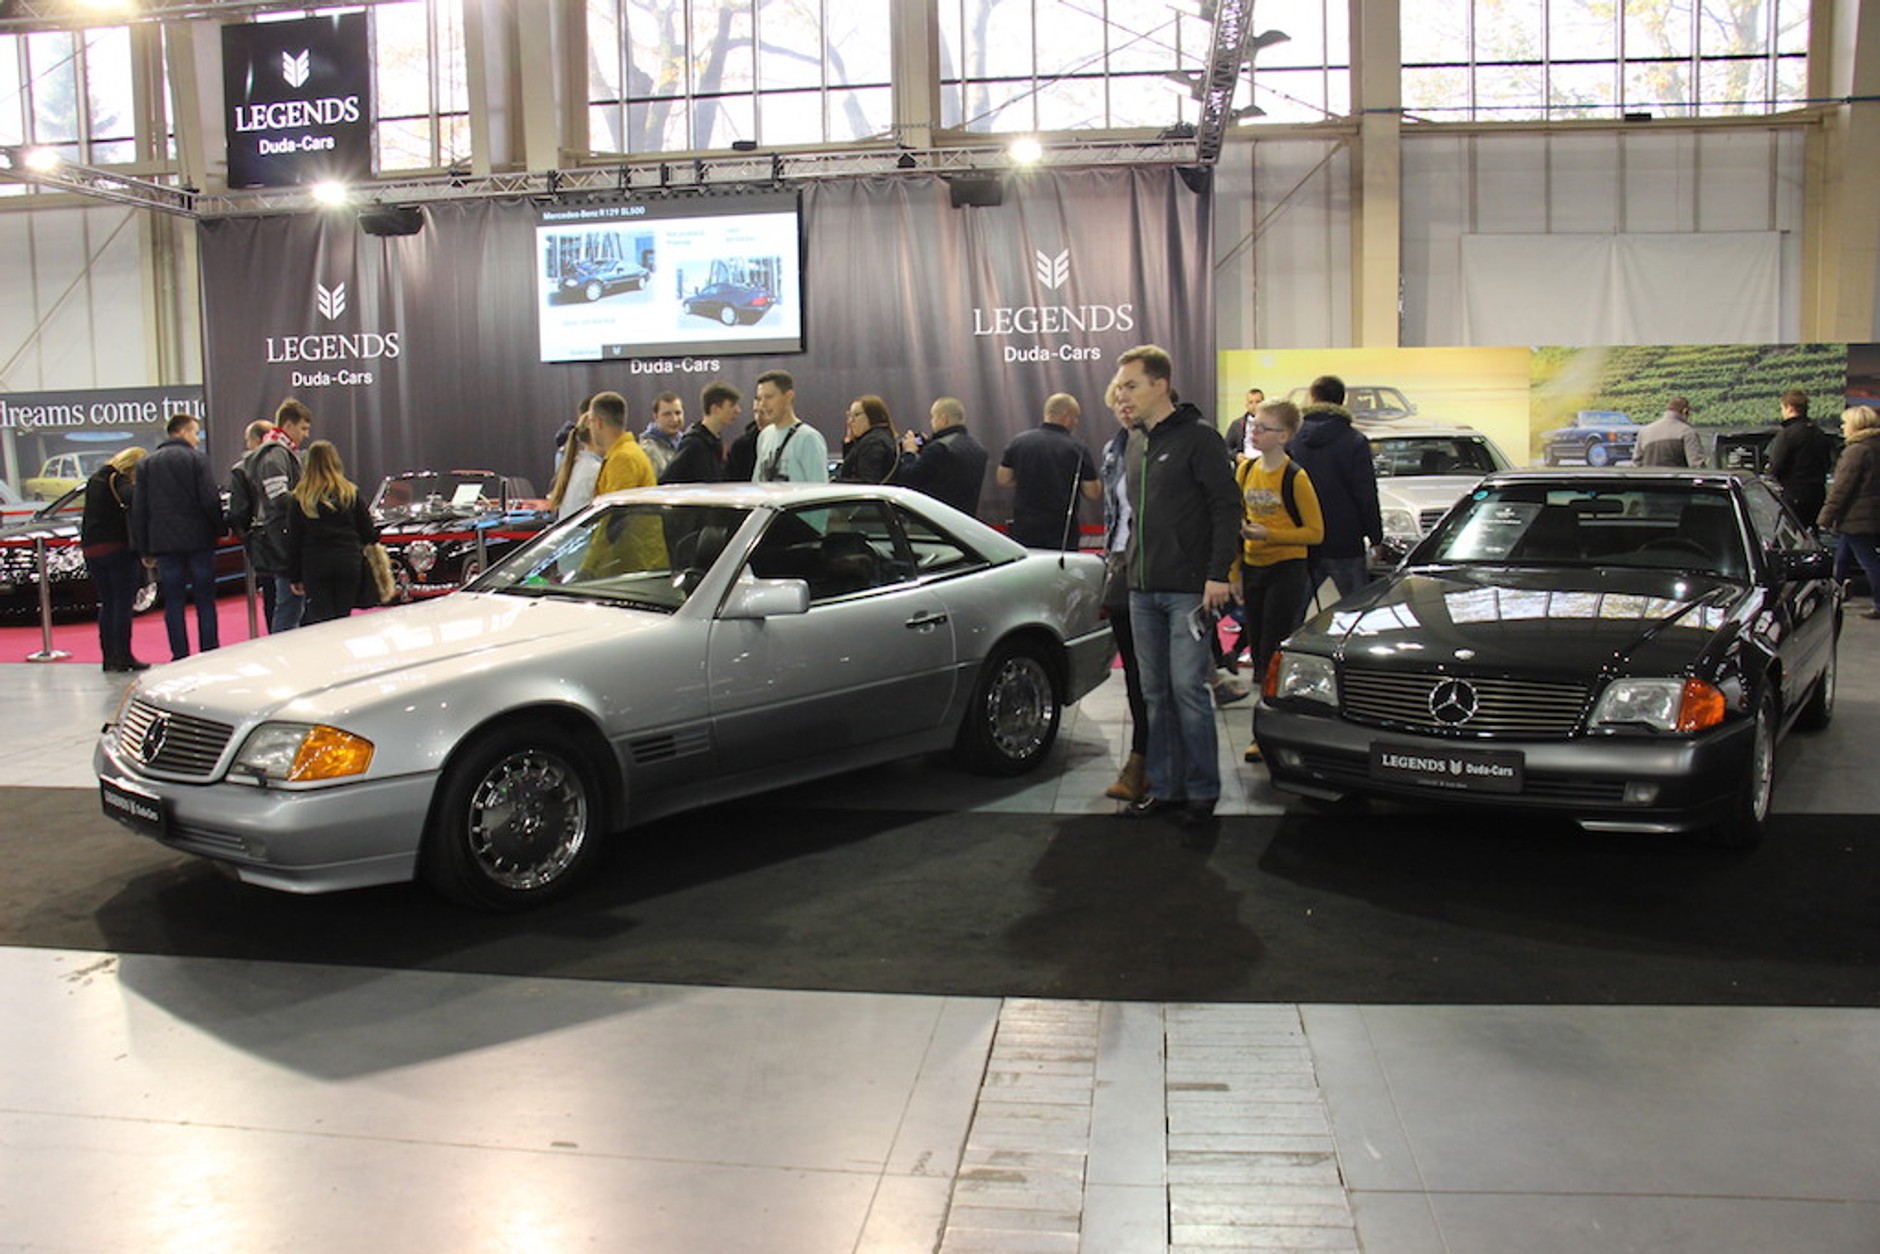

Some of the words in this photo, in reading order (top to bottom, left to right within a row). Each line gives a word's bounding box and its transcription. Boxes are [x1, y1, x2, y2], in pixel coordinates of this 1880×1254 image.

[235, 96, 359, 131] LEGENDS
[259, 135, 335, 155] Duda-Cars
[973, 304, 1133, 335] LEGENDS
[266, 332, 399, 362] LEGENDS
[1004, 344, 1101, 362] Duda-Cars
[630, 358, 721, 375] Duda-Cars
[291, 369, 373, 387] Duda-Cars
[90, 402, 158, 424] come
[162, 396, 206, 422] tru
[1382, 754, 1446, 772] LEGENDS
[1466, 763, 1513, 776] Duda-Cars
